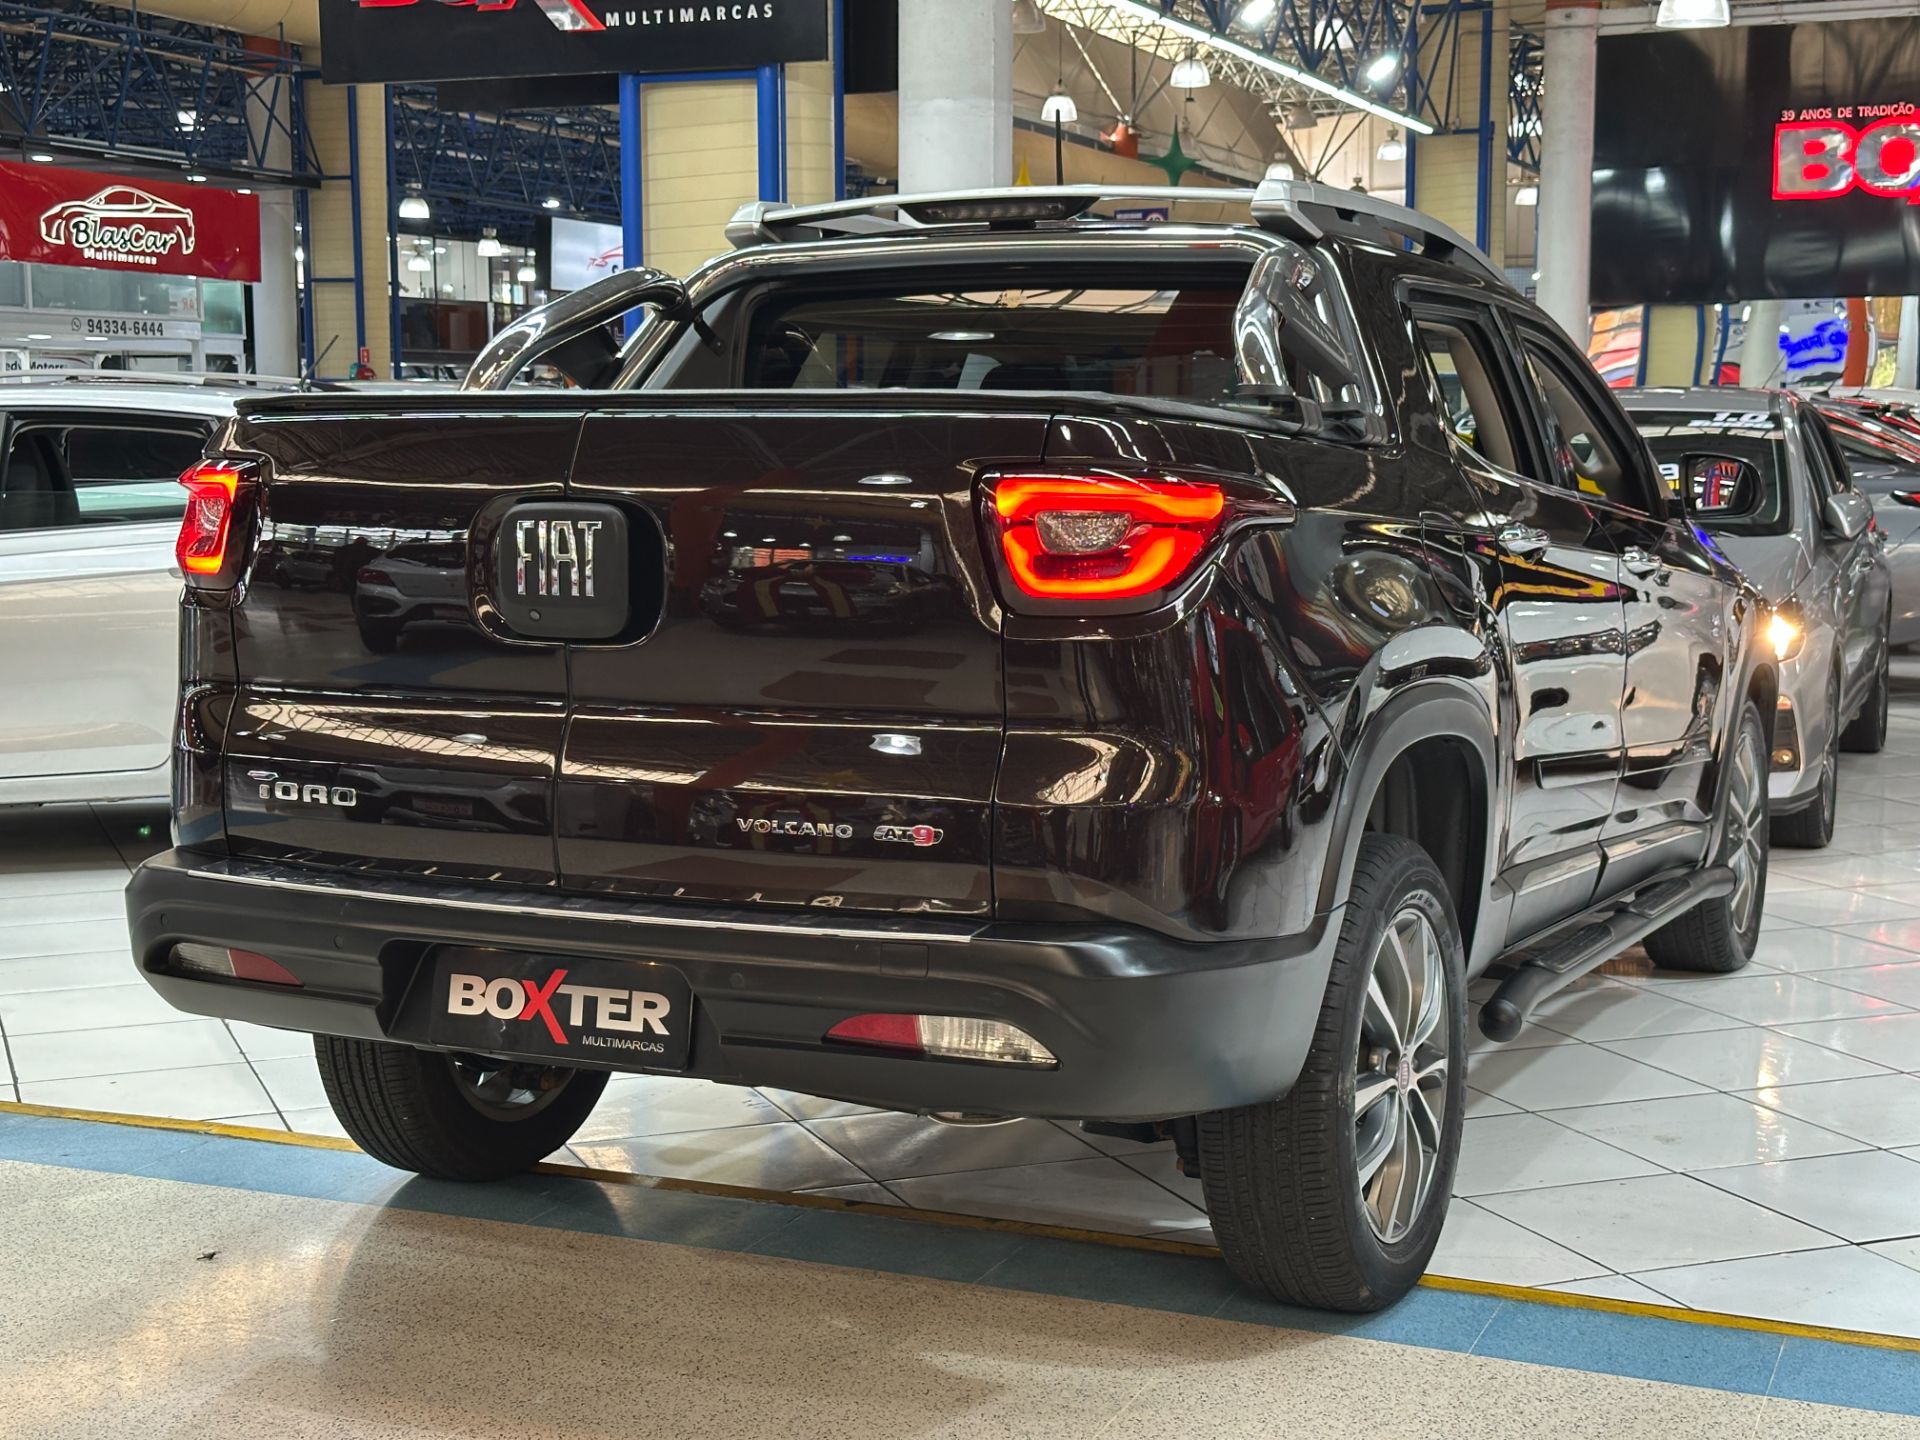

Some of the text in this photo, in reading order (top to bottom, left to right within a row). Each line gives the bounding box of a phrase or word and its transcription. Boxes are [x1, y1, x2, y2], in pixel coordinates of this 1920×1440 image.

[606, 3, 774, 28] MULTIMARCAS
[1781, 101, 1915, 121] 39 ANOS DE TRADIÇÃO
[1772, 111, 1920, 205] BO
[71, 216, 176, 255] BlasCar
[83, 247, 158, 266] Multimarcas
[87, 318, 164, 337] 94334-6444
[516, 520, 602, 597] FIAT
[247, 770, 357, 807] TORO
[736, 818, 937, 846] VOLCANO AT9
[447, 968, 671, 1045] BOXTER
[582, 1035, 665, 1053] MULTIMARCAS
